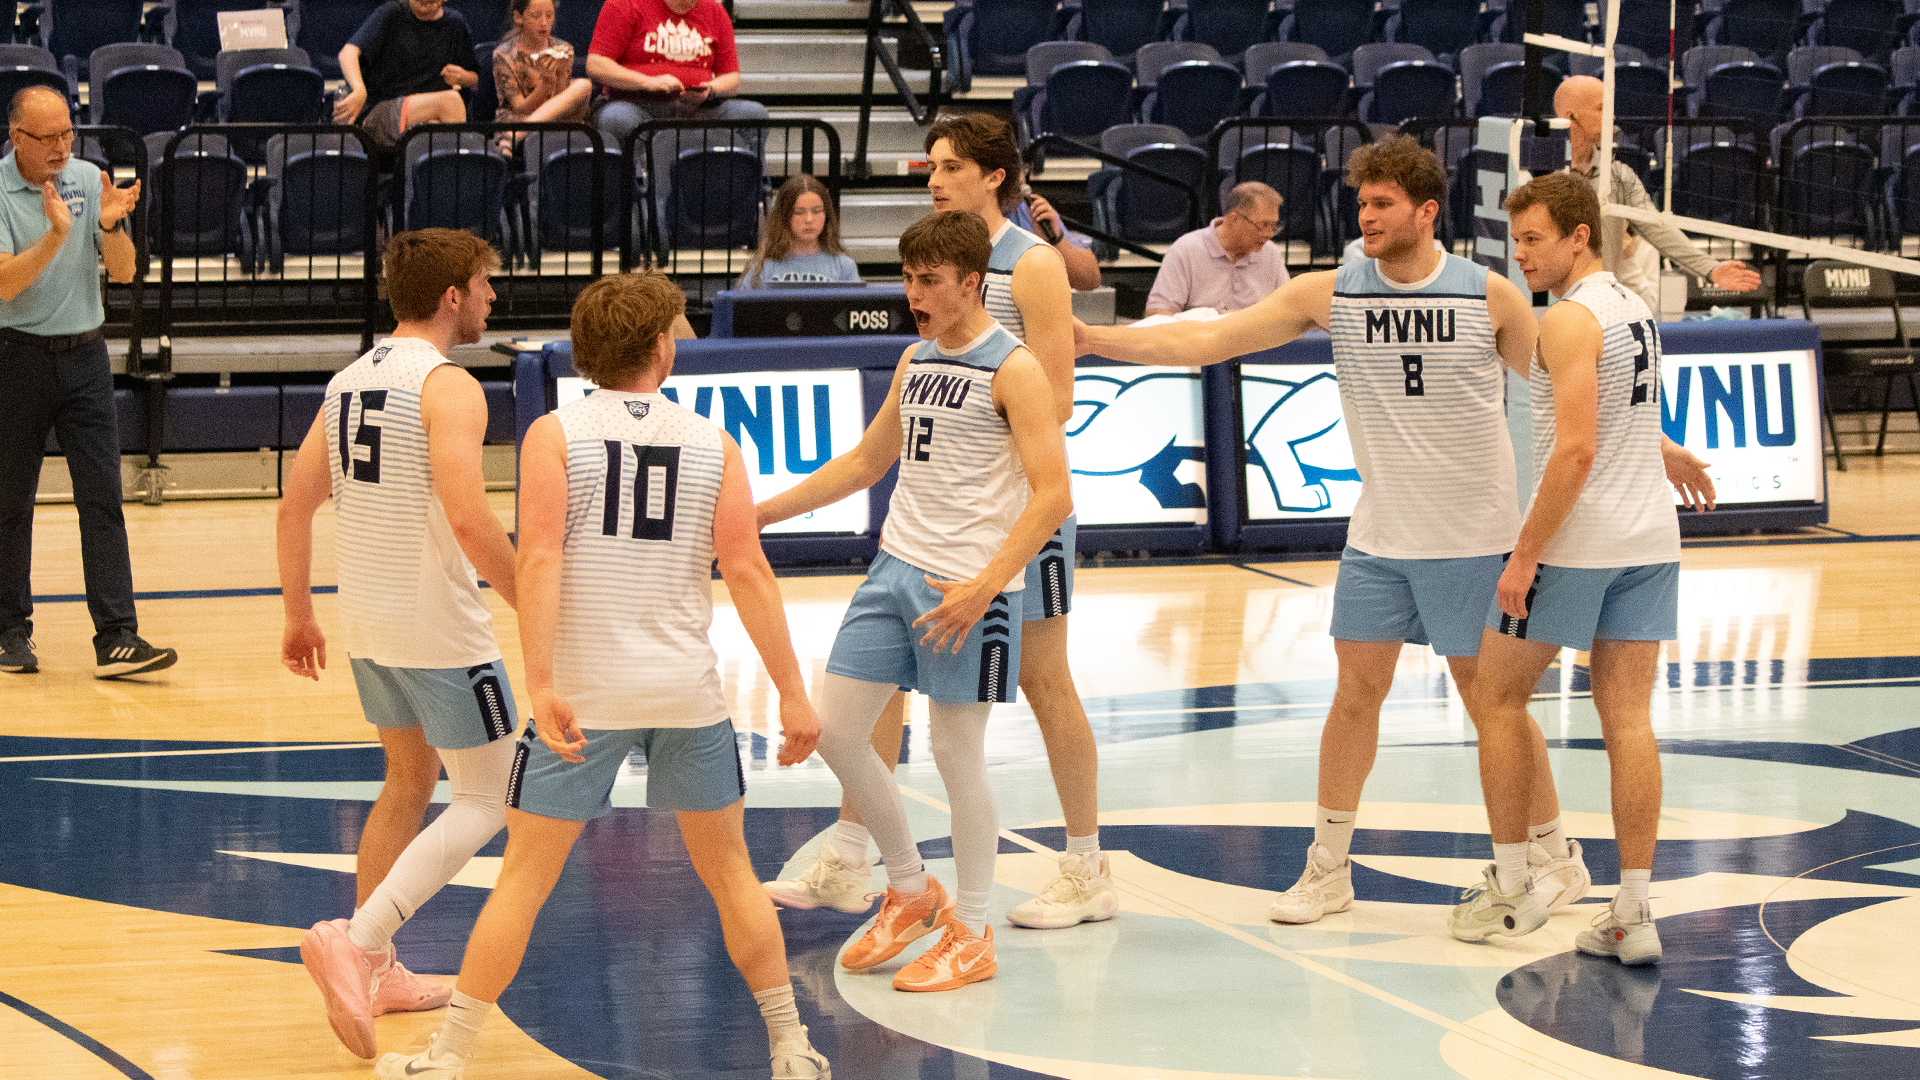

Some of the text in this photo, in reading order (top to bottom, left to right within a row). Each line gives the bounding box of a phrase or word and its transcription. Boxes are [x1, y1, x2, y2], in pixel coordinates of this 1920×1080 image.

[1824, 268, 1871, 288] MVNU
[849, 310, 889, 330] POSS
[1365, 309, 1455, 343] MVNU
[901, 373, 973, 410] MVNU
[1400, 354, 1425, 396] 8
[1661, 363, 1797, 449] VNU
[339, 390, 389, 484] 15
[907, 416, 934, 462] 12
[602, 439, 682, 541] 10
